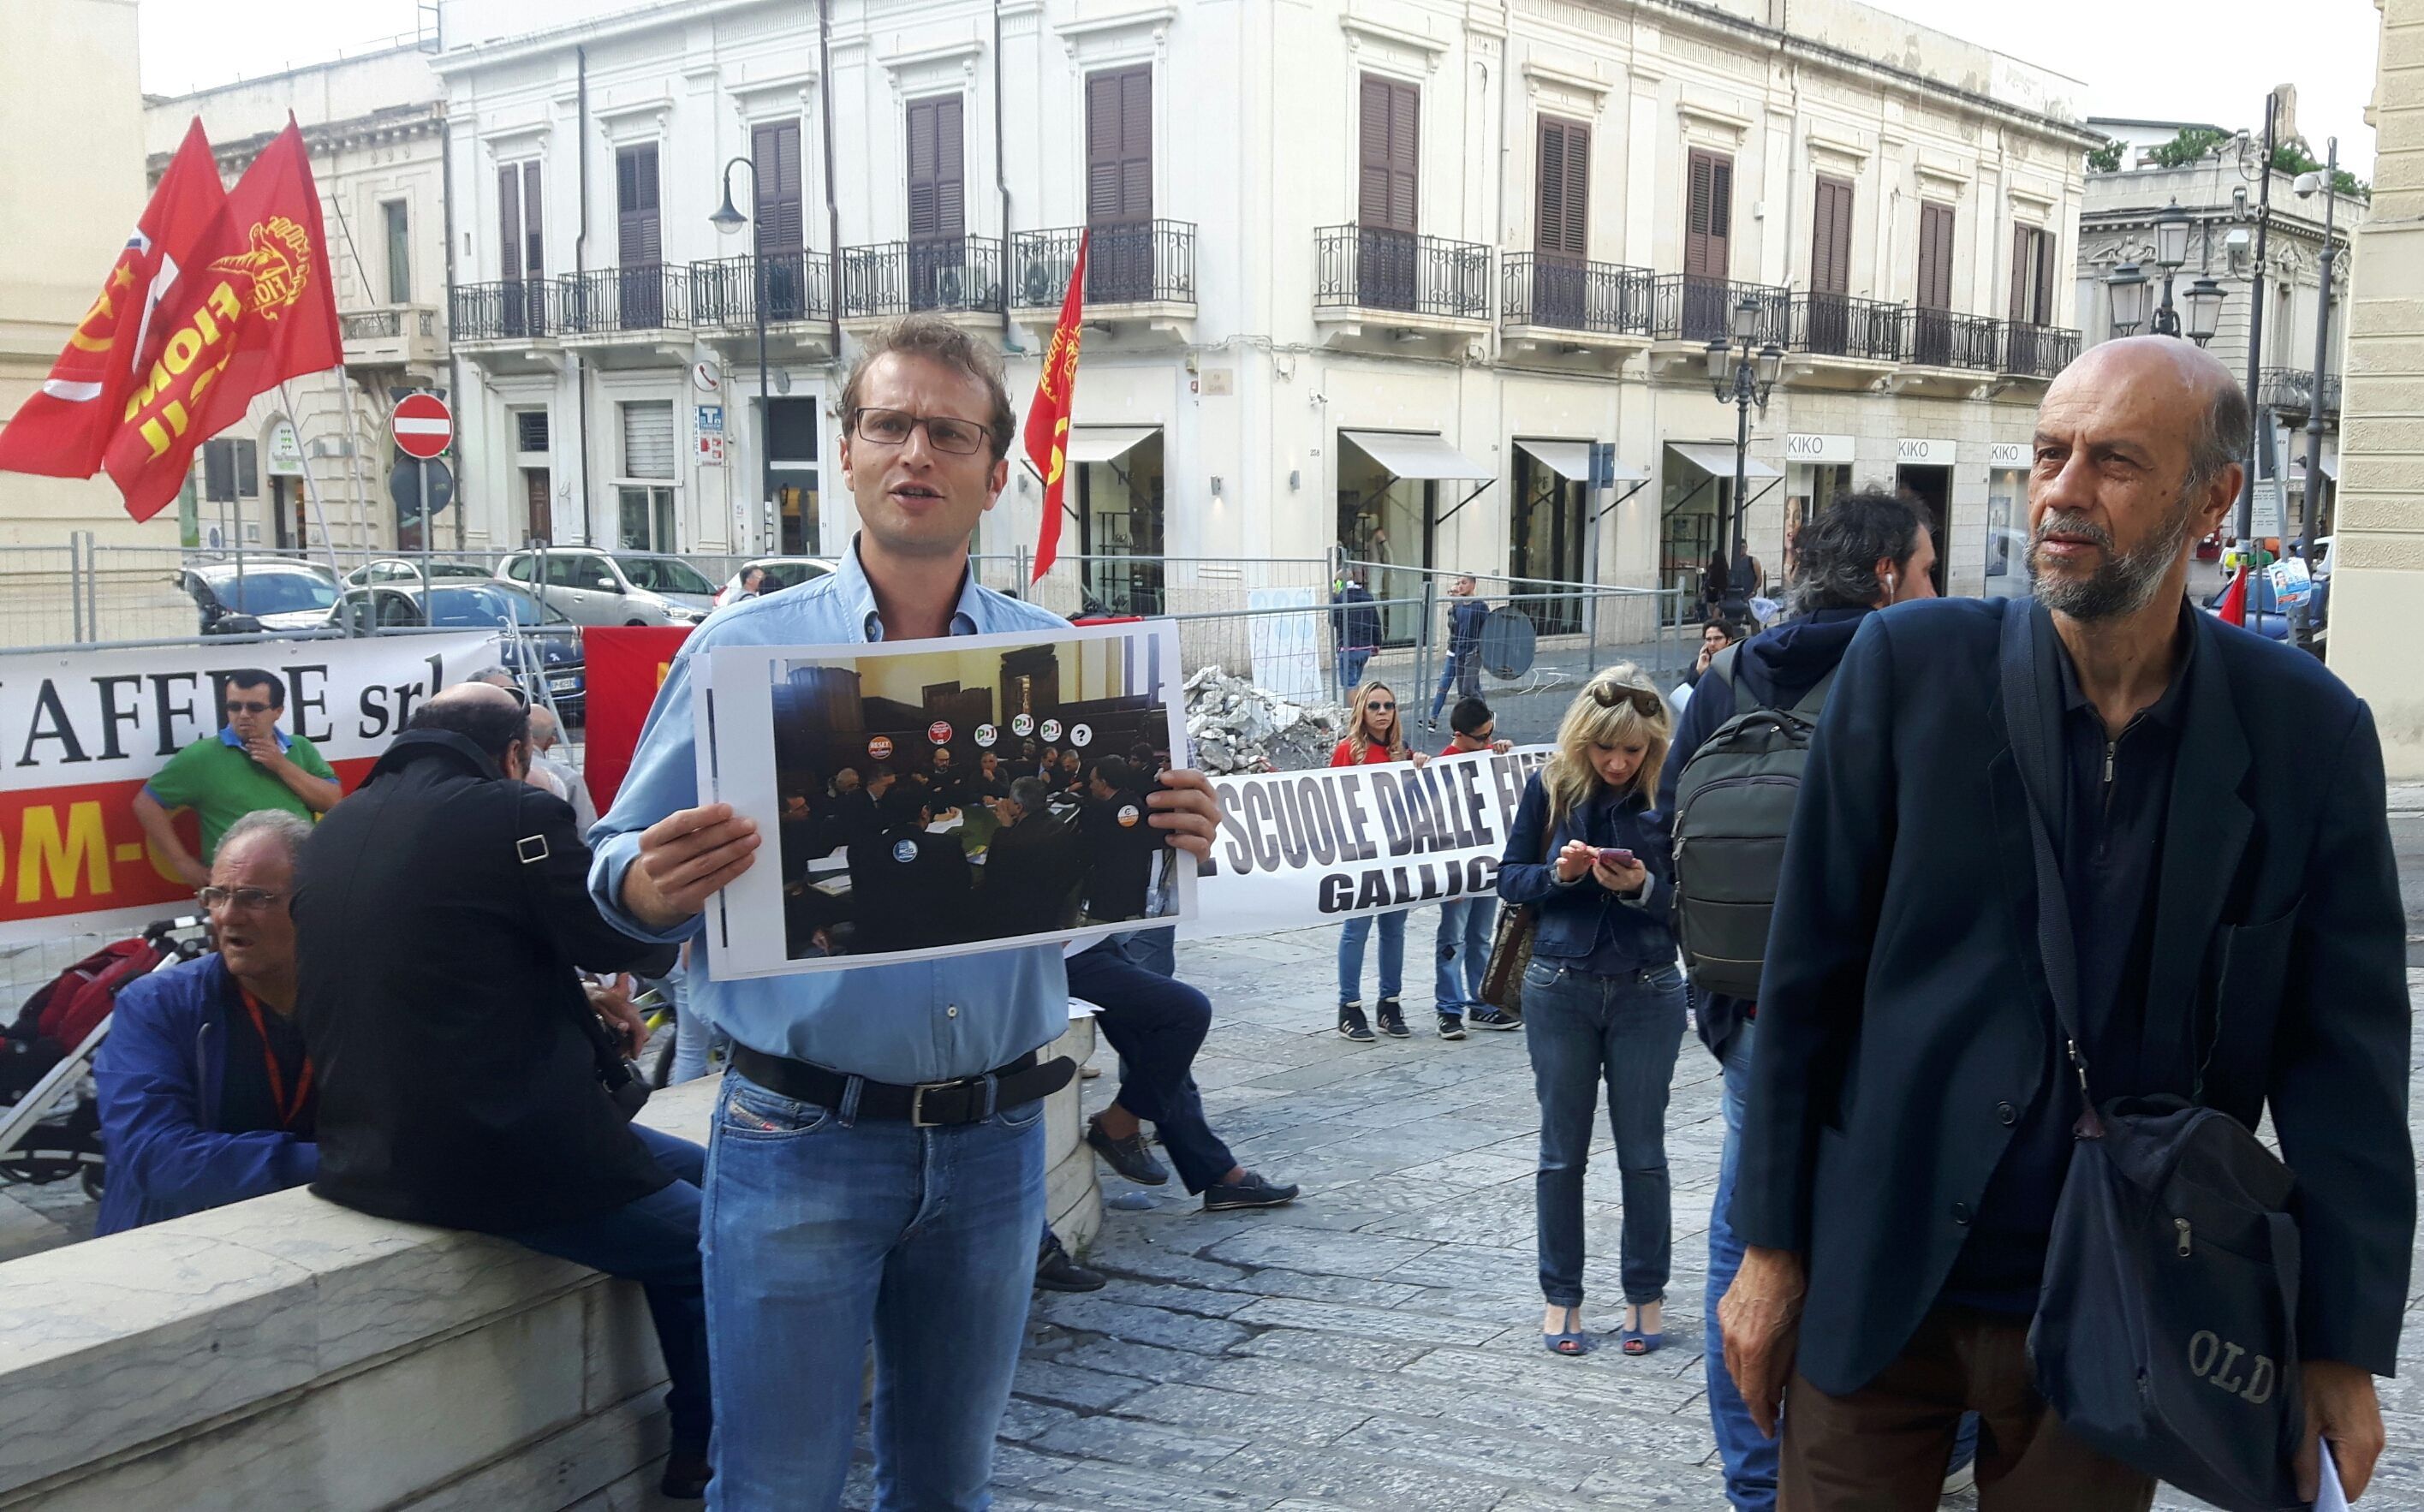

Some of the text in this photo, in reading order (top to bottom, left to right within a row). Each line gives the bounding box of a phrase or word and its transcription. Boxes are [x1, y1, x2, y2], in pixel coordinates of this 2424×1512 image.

[1788, 437, 1823, 454] KIKO
[1897, 441, 1928, 457] KIKO
[1992, 445, 2018, 460] KIKO
[1076, 729, 1086, 741] ?
[1217, 774, 1378, 875] SCUOLE
[1370, 759, 1494, 857] DALLE
[2189, 1329, 2276, 1404] OLD
